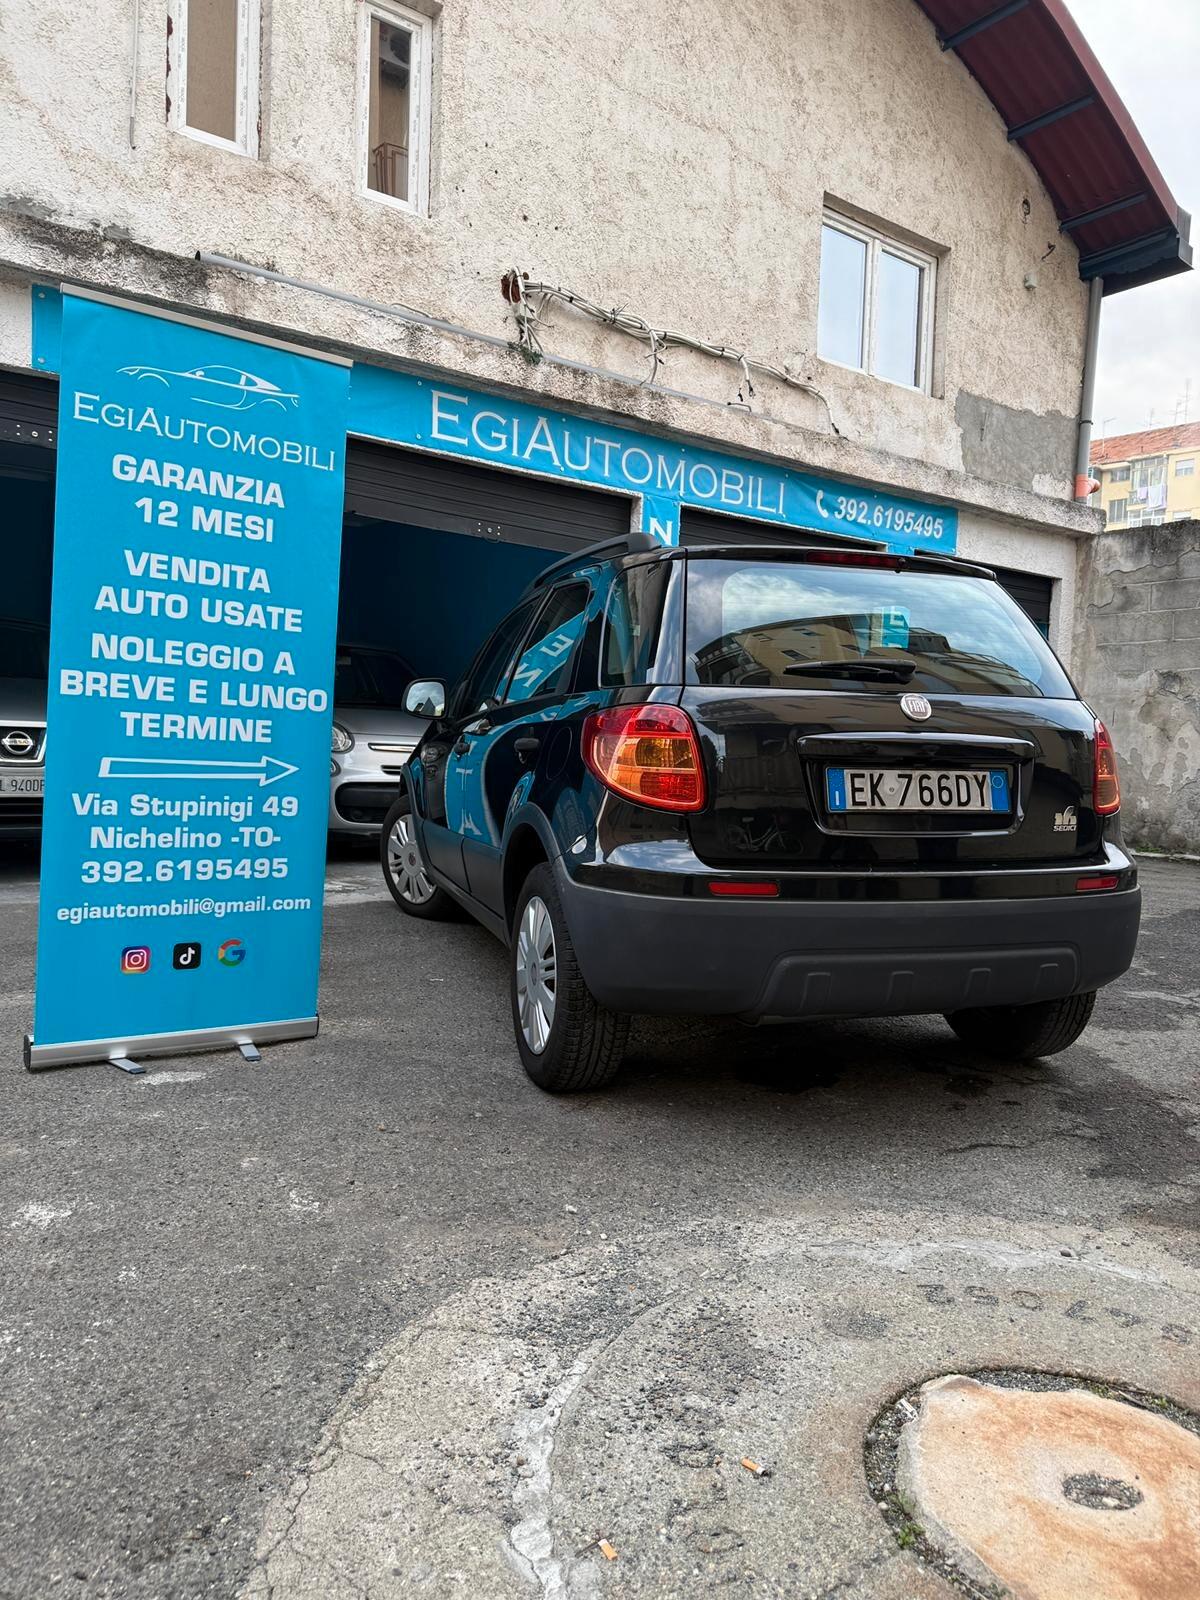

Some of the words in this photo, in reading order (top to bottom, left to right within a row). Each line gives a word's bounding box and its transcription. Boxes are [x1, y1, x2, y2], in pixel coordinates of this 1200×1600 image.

[112, 454, 285, 508] GARANZIA
[135, 497, 179, 528] 12
[192, 506, 274, 542] MESI
[834, 496, 944, 539] 392.6195495
[124, 549, 271, 593] VENDITA
[94, 585, 188, 619] AUTO
[201, 598, 303, 632] USATE
[91, 633, 264, 673] NOLEGGIO
[273, 651, 296, 676] A
[60, 669, 175, 702] BREVE
[189, 679, 208, 704] E
[221, 681, 328, 712] LUNGO
[120, 711, 272, 743] TERMINE
[72, 793, 118, 816] Via
[131, 794, 253, 822] Stupinigi
[262, 796, 298, 817] 49
[850, 773, 887, 806] EK
[898, 774, 988, 806] 766DY
[90, 826, 223, 849] Nichelino
[231, 826, 281, 848] -TO-
[81, 857, 289, 884] 392.6195495
[57, 896, 311, 924] egiautomobili@gmail.com
